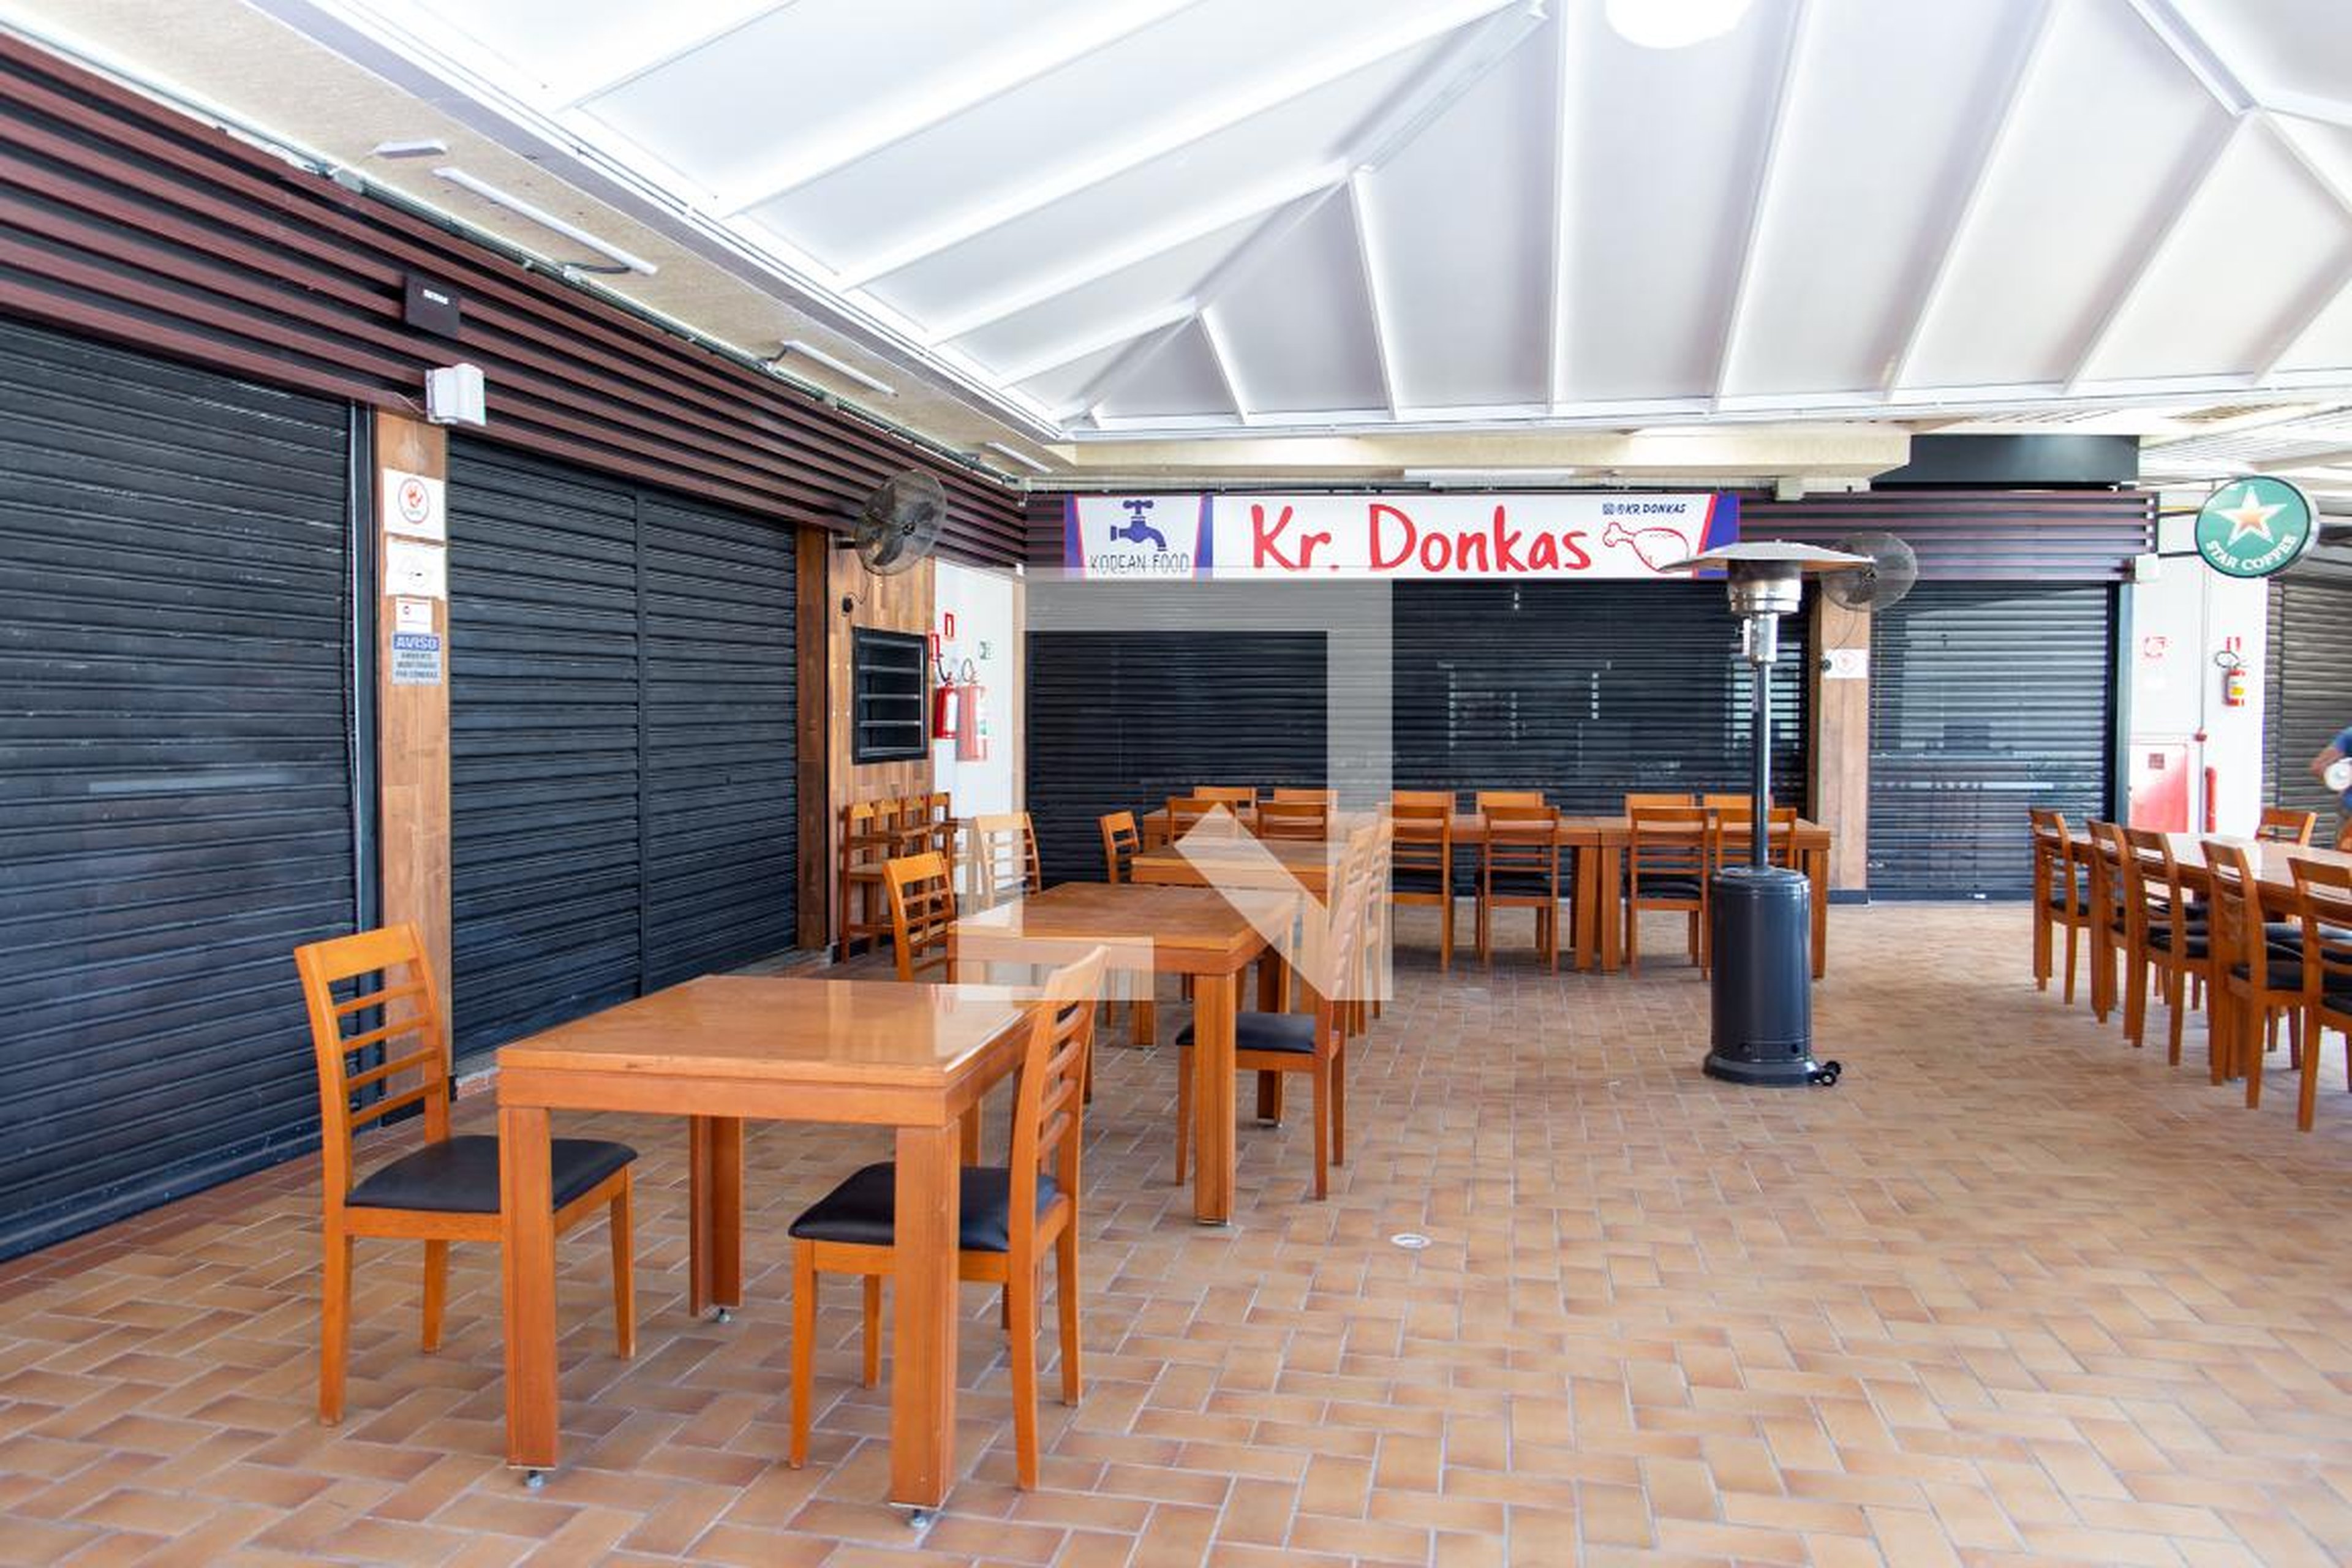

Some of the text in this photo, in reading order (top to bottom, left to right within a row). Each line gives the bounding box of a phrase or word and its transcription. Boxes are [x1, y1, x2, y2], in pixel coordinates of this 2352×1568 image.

[1251, 504, 1591, 572] Kr. Donkas
[2206, 533, 2297, 570] STAR COFFEE
[1090, 553, 1189, 573] KOREAN FOOD
[396, 636, 438, 649] AVISO
